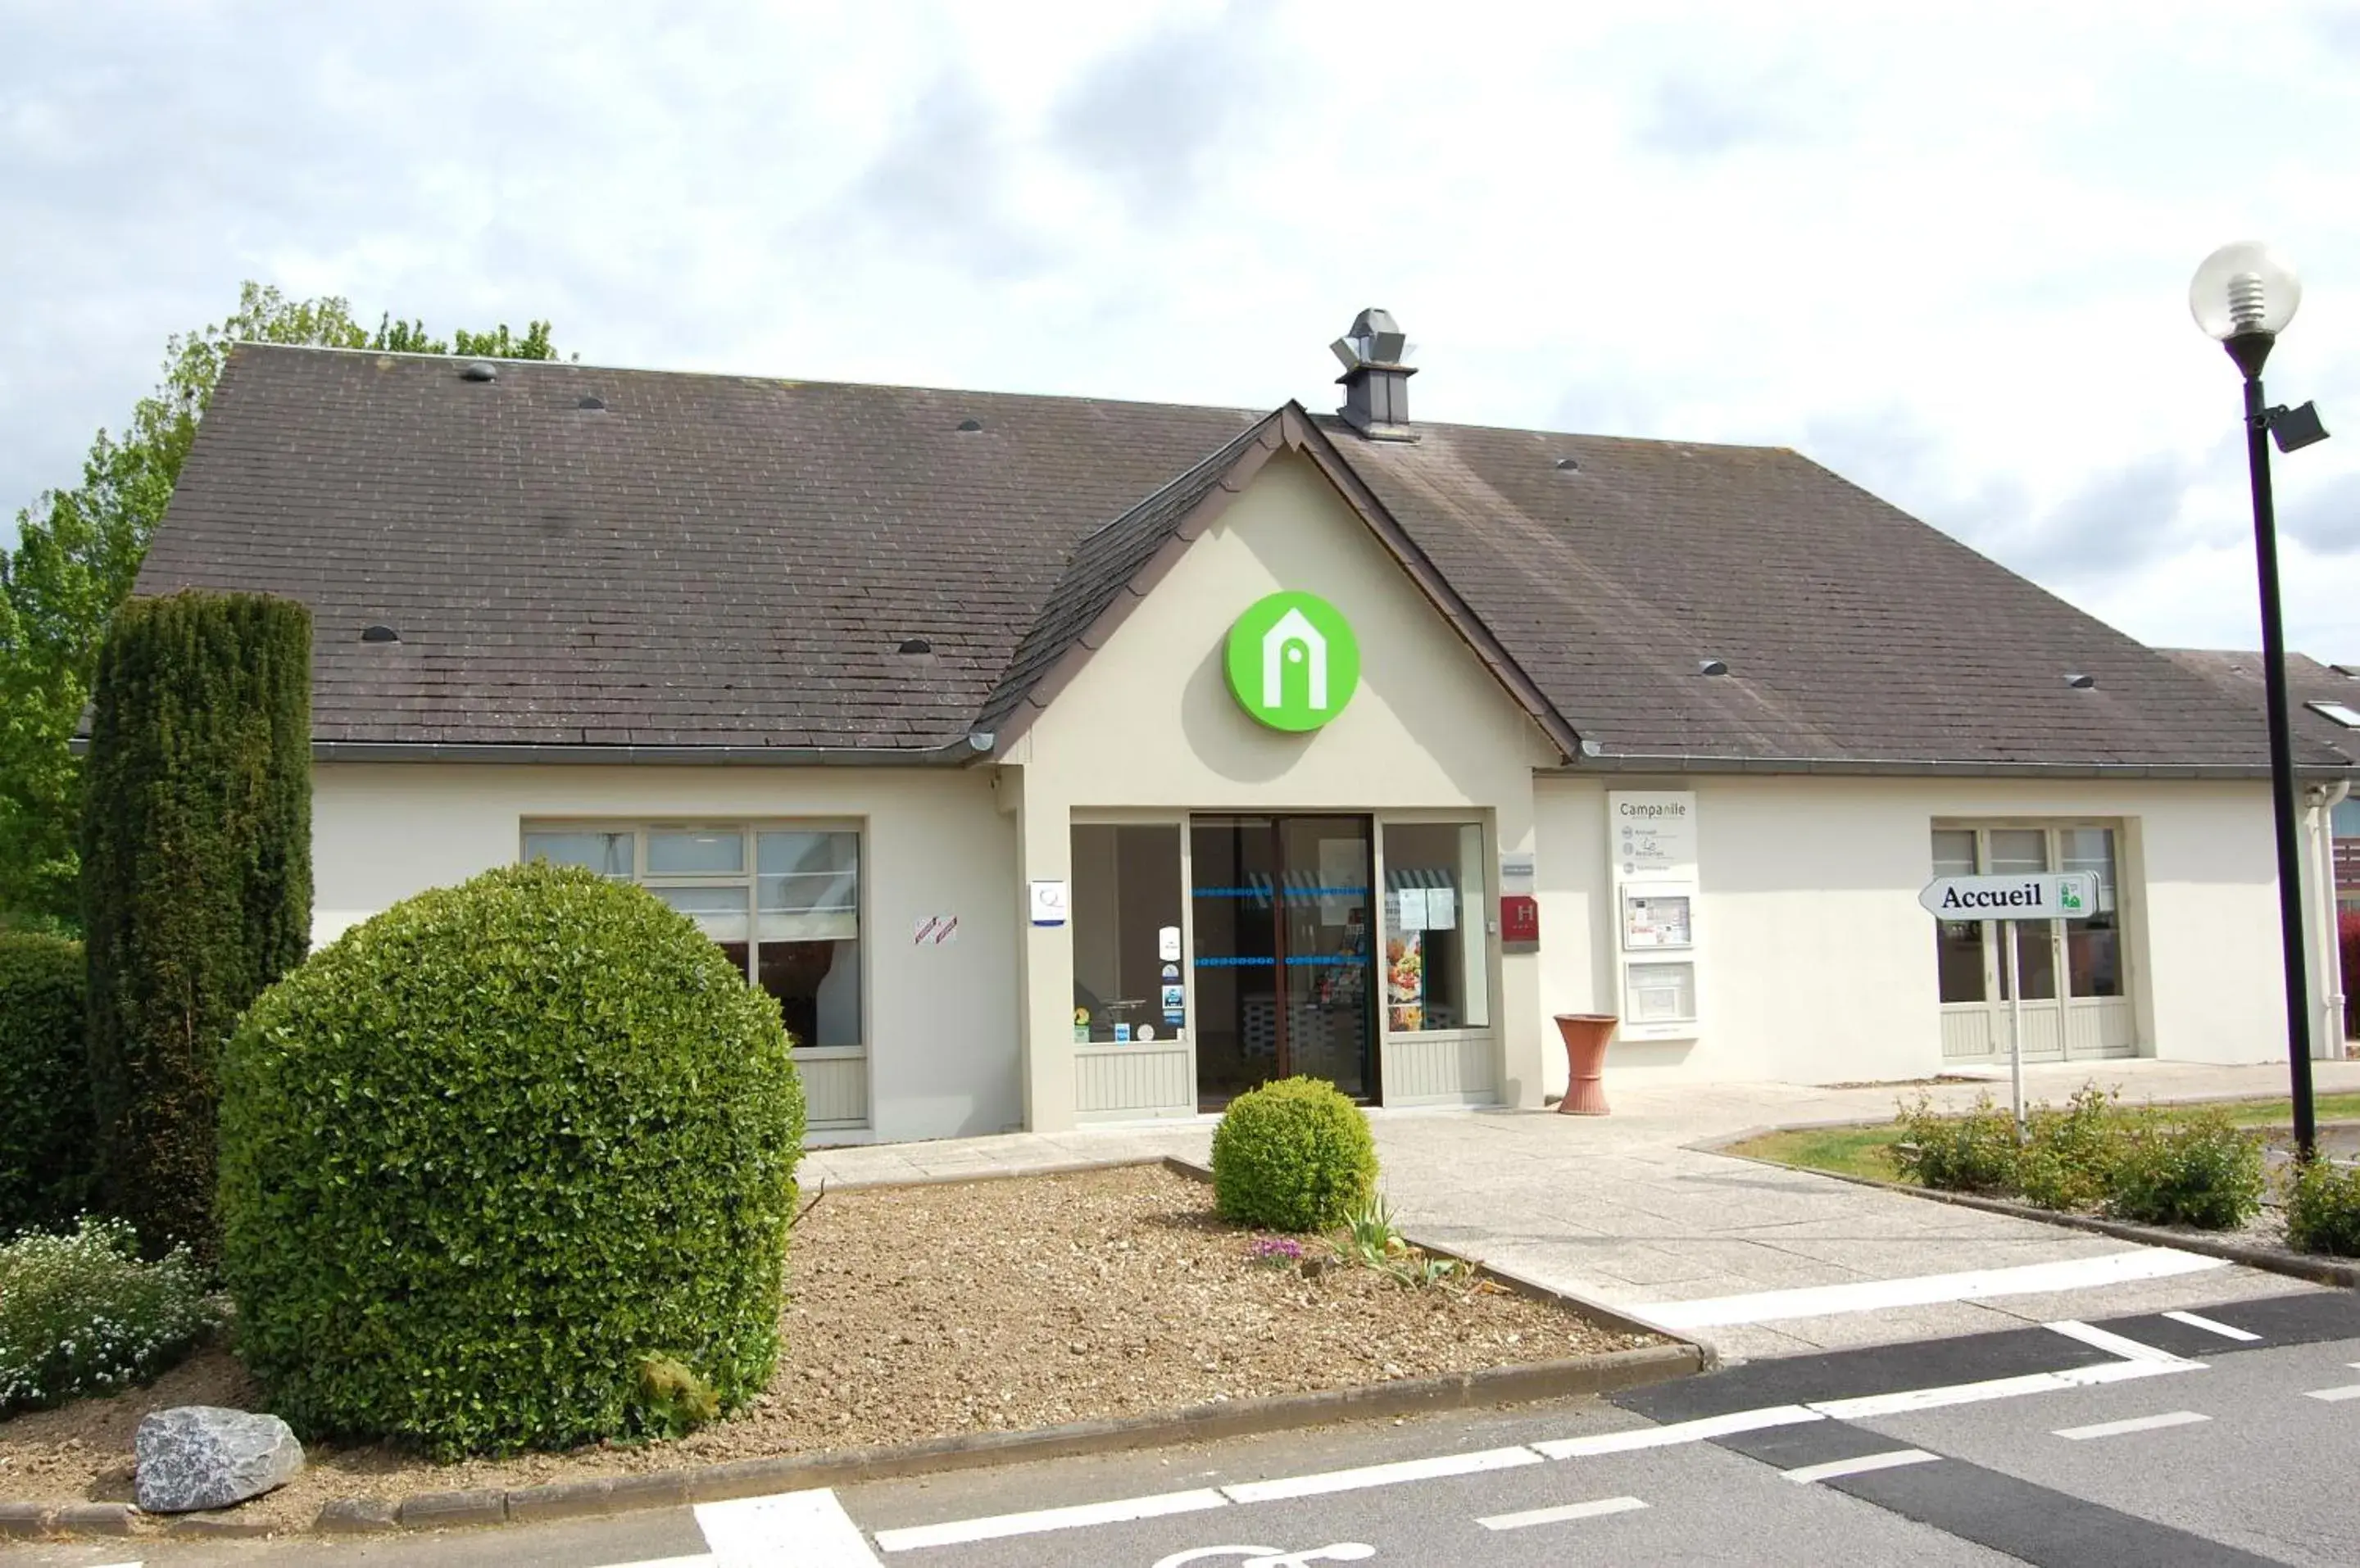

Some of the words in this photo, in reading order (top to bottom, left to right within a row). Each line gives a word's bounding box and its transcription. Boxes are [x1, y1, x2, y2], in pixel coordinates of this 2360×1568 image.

[1620, 802, 1686, 819] Campanile
[1942, 883, 2043, 909] Accueil
[1518, 904, 1533, 921] H
